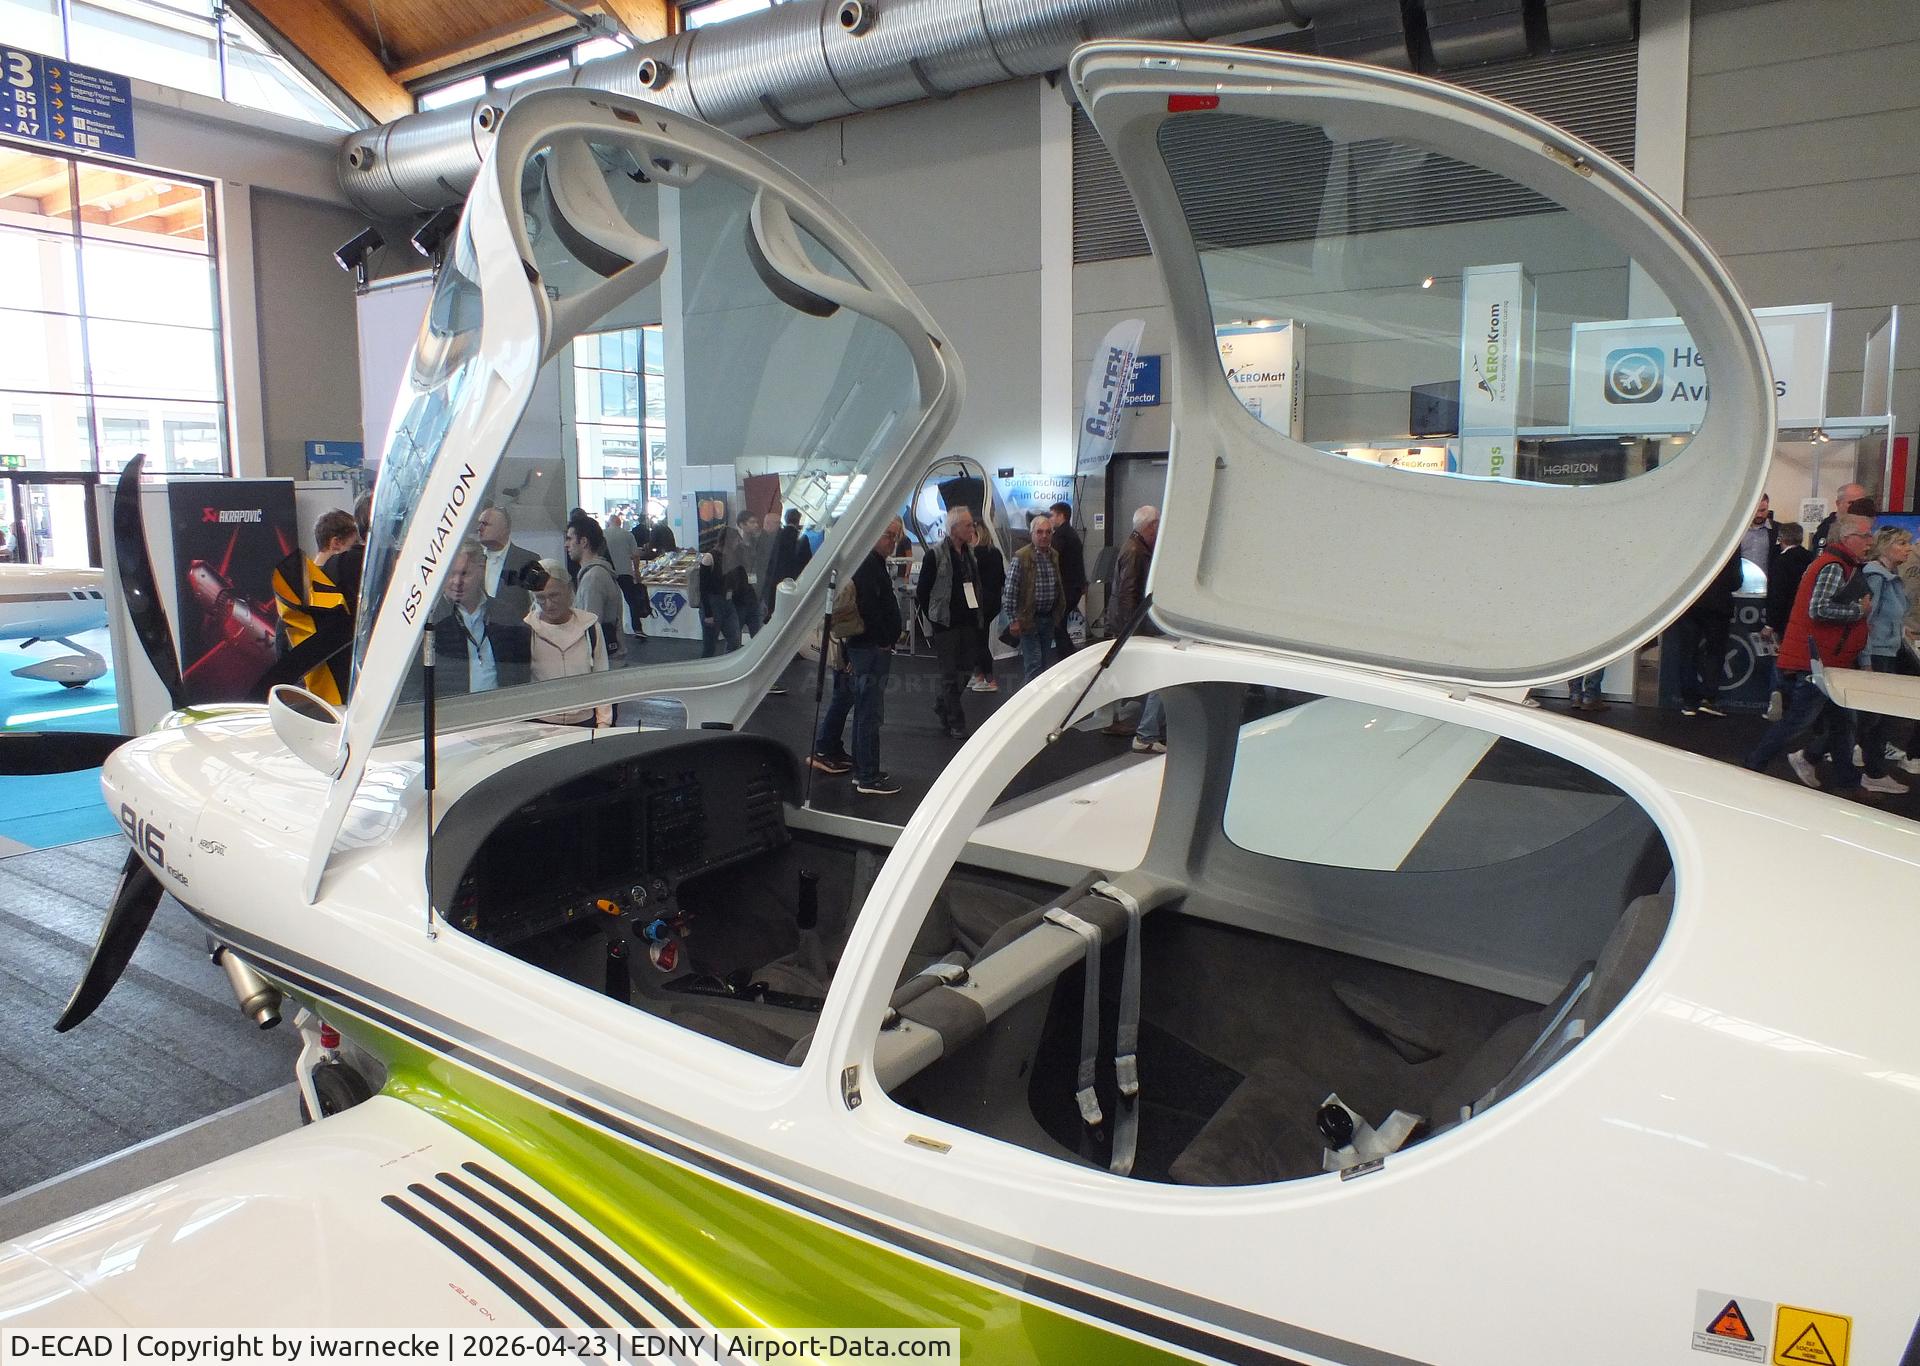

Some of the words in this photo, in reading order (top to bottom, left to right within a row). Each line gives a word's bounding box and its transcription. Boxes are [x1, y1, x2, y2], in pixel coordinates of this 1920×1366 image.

[0, 52, 34, 88] 3
[15, 89, 37, 105] B5
[16, 104, 37, 120] B1
[17, 121, 40, 136] A7
[1543, 463, 1599, 475] HORIZON
[1005, 478, 1070, 488] Sonnenschutz
[1020, 491, 1032, 500] im
[1033, 490, 1069, 503] Cockpit
[402, 584, 422, 625] ISS
[421, 463, 476, 586] AVIATION
[121, 802, 166, 869] 916
[1796, 1345, 1824, 1355] LOCATED
